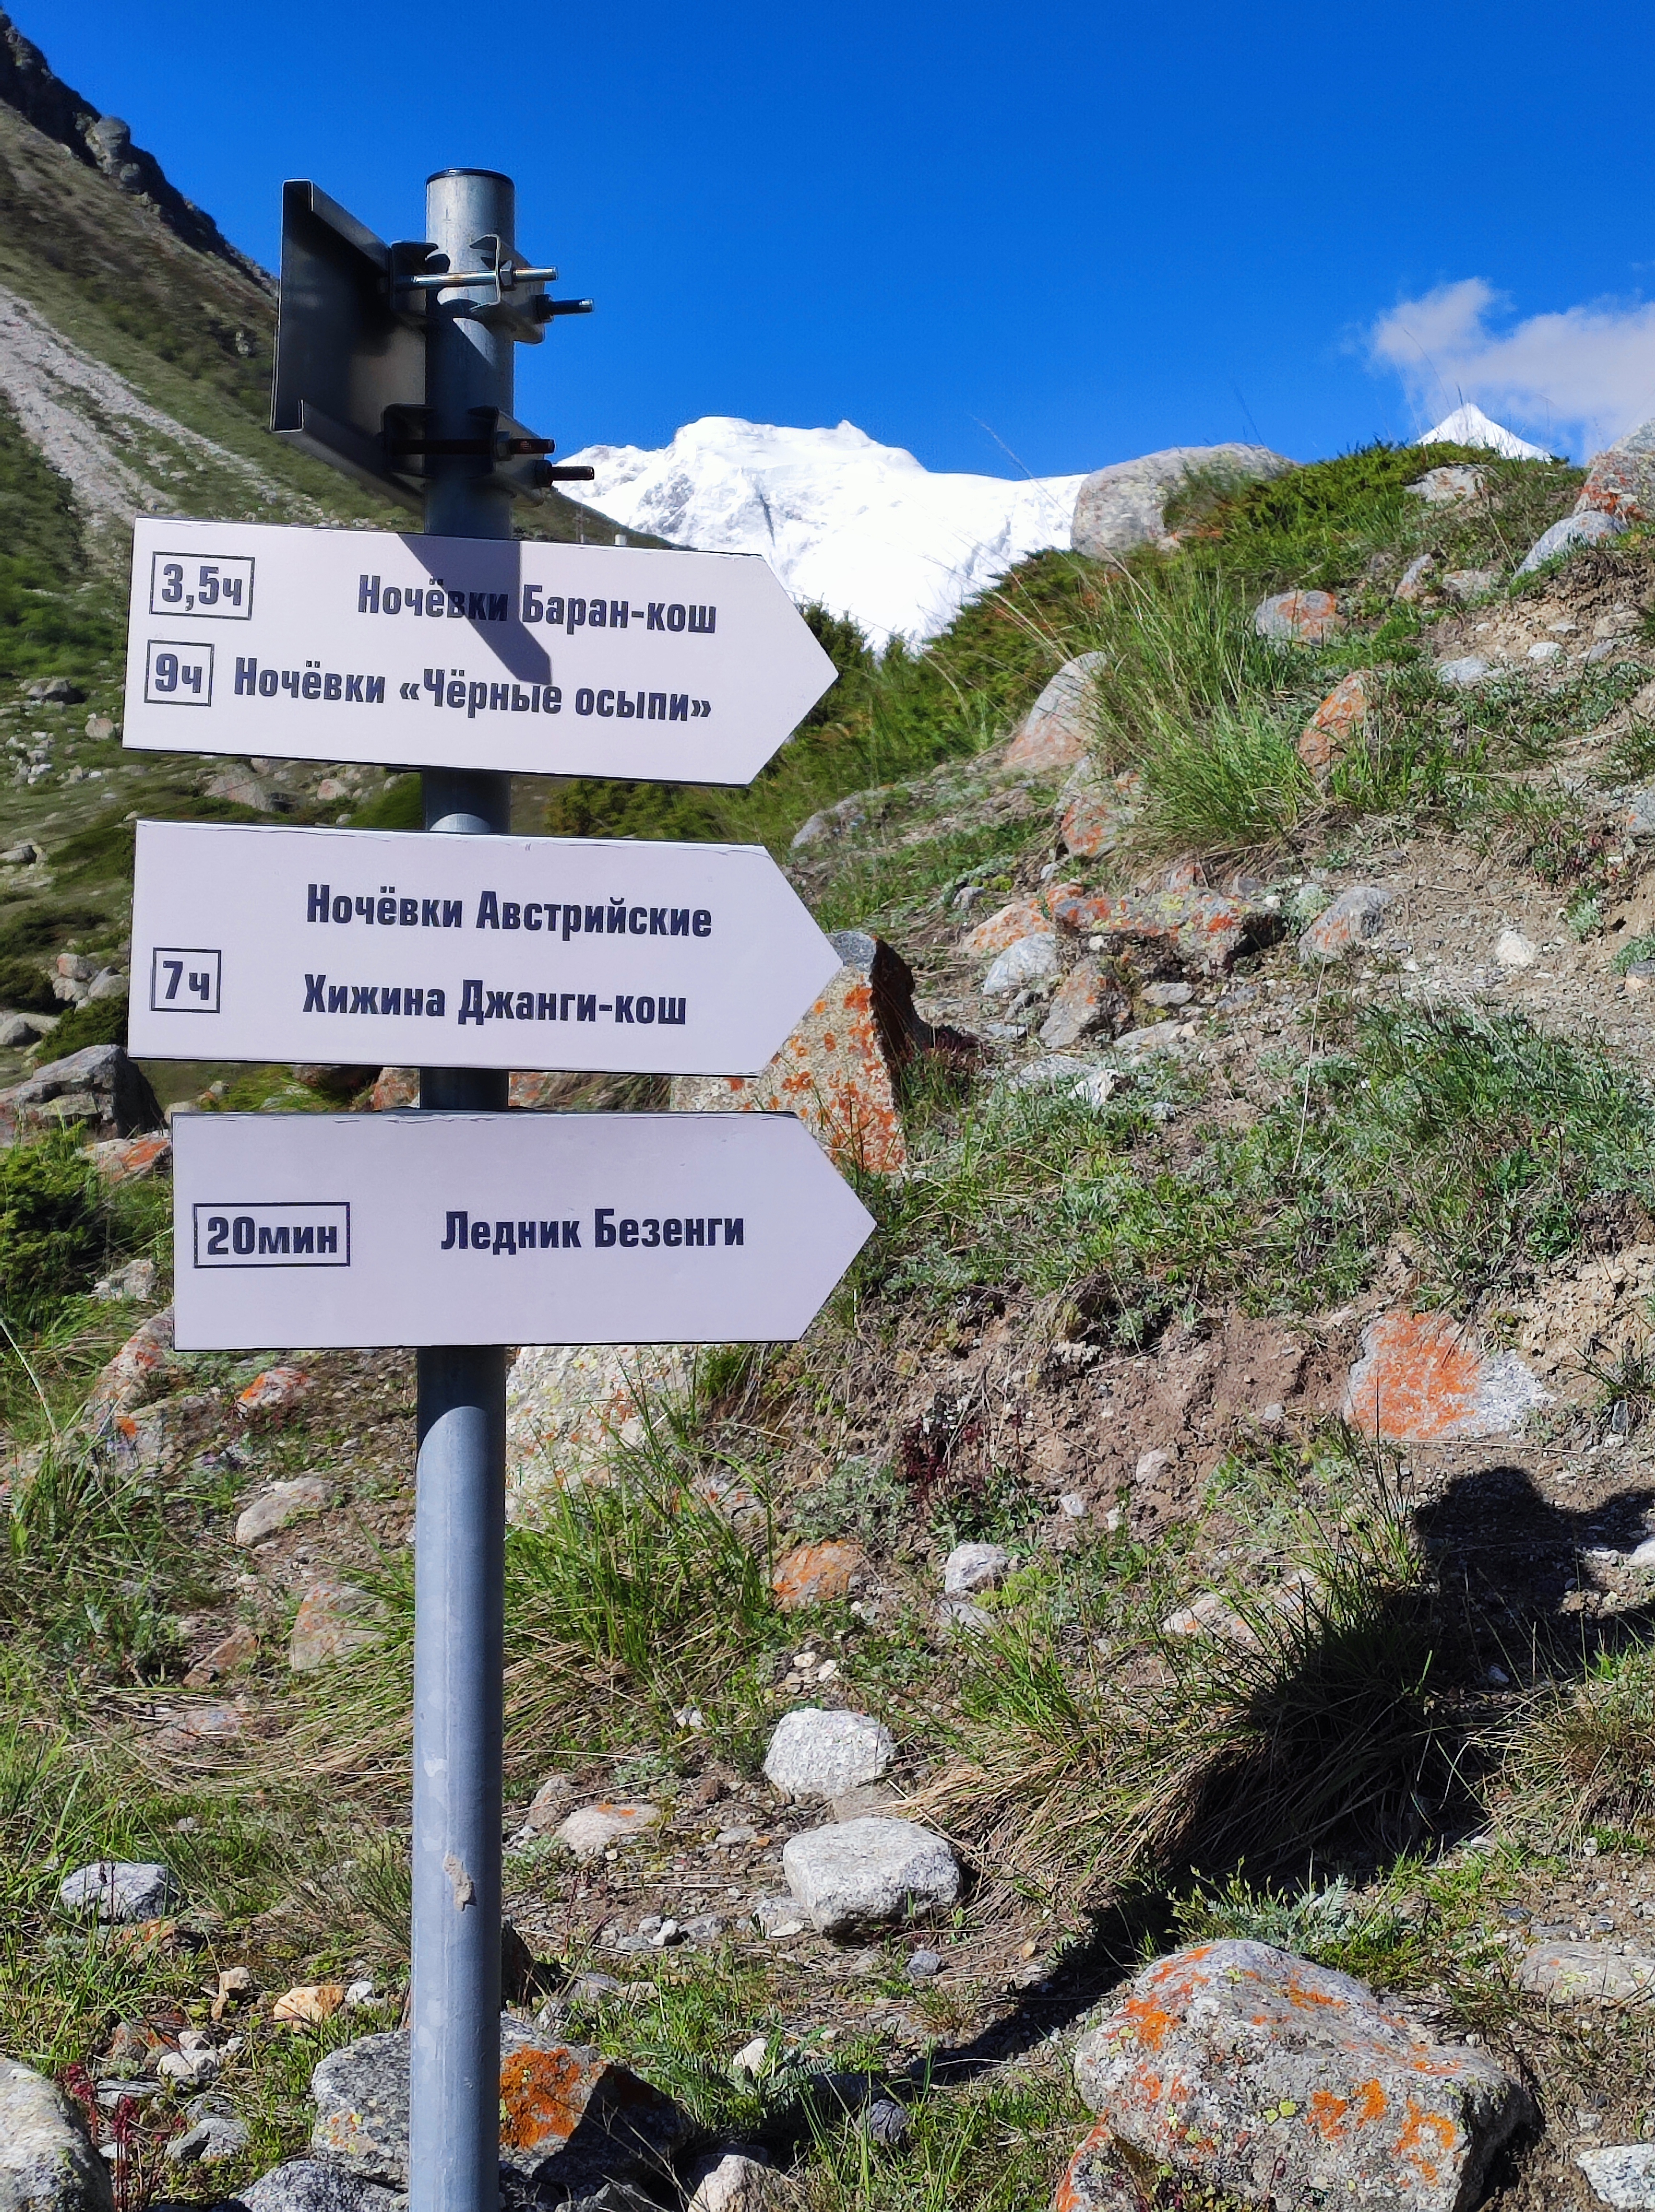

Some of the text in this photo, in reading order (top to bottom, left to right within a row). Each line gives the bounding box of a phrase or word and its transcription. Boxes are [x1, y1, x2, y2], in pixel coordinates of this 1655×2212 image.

[162, 564, 242, 611] 3,5ч
[358, 574, 716, 635] Ночёвки Баран-кош
[155, 654, 202, 693] 9ч
[235, 657, 711, 721] Ночёвки «Чёрные осыпи»
[307, 884, 711, 941] Ночёвки Австрийские
[163, 961, 209, 1000] 7ч
[303, 974, 686, 1025] Хижина Джанги-кош
[207, 1217, 337, 1255] 20мин
[441, 1208, 744, 1255] Ледник Безенги
